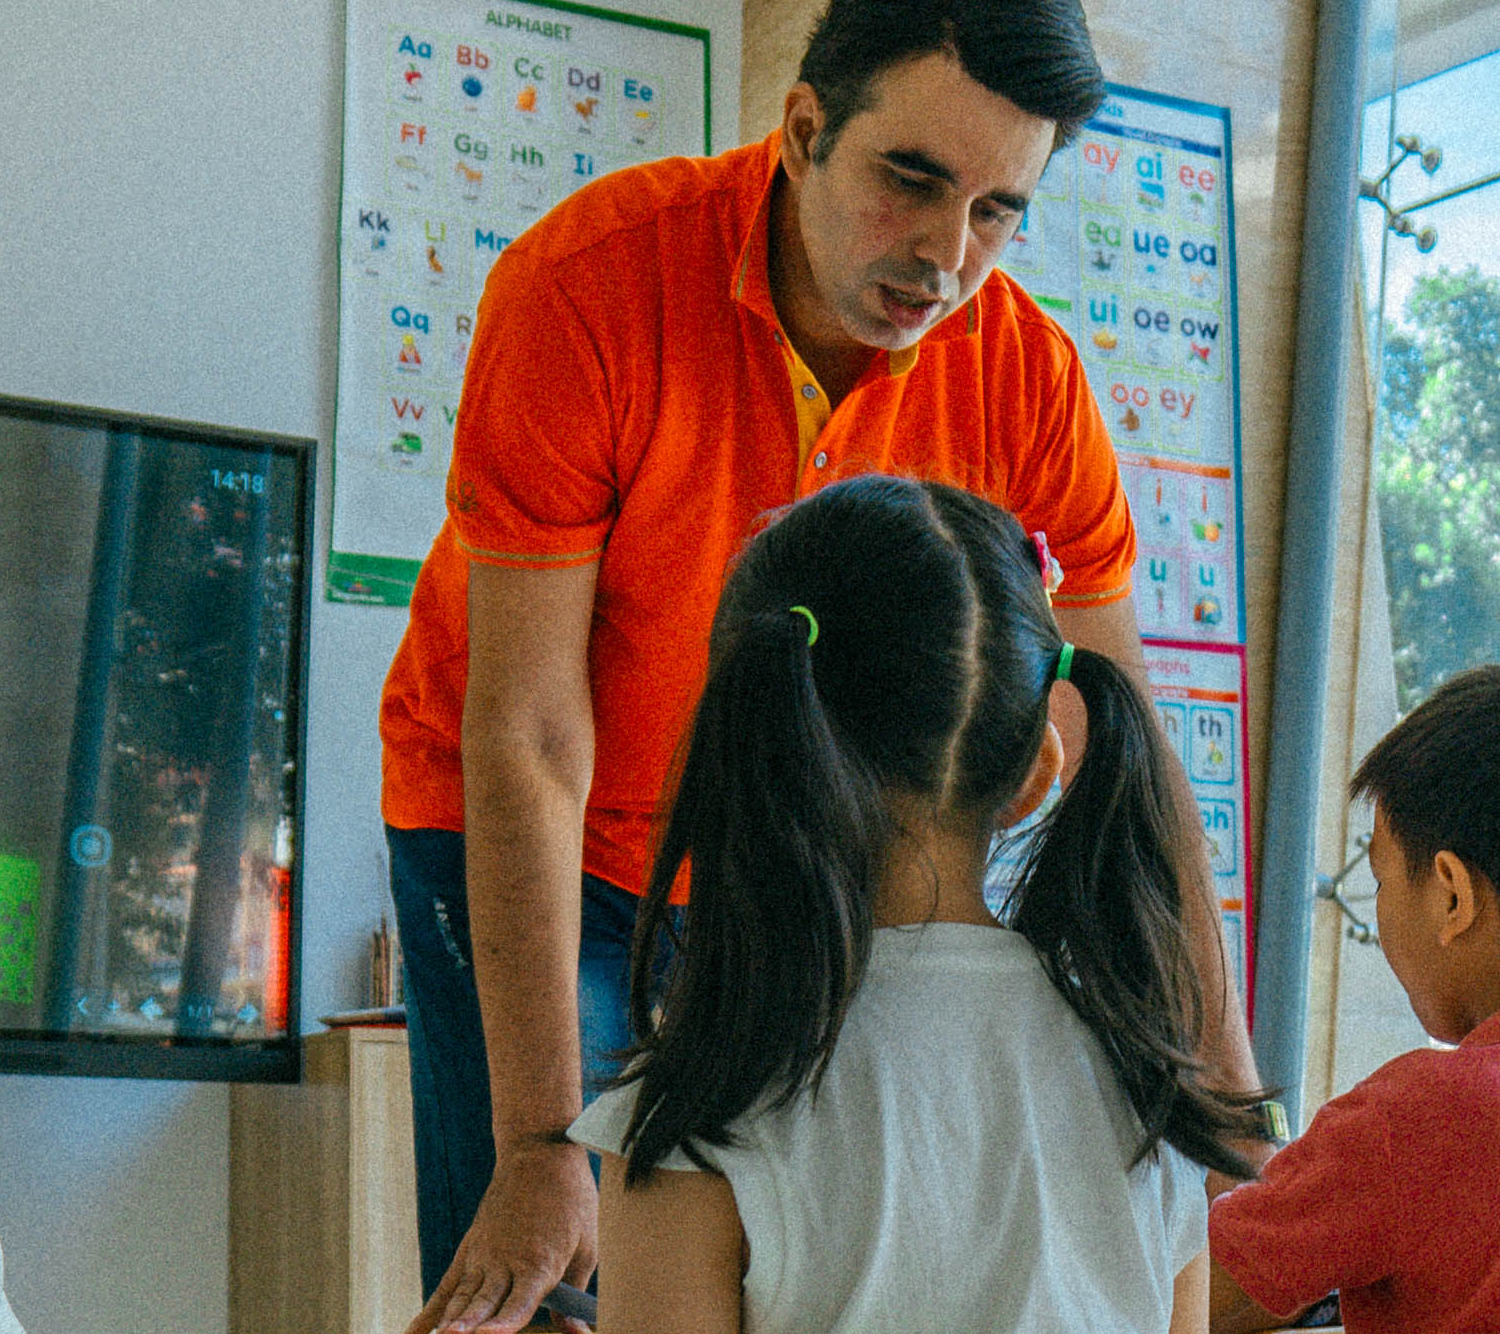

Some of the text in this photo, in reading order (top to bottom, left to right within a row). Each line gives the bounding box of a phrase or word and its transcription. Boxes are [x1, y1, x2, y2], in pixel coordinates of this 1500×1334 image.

[485, 9, 573, 41] ALPHABET
[398, 35, 653, 102] Aa Bb Cc Dd Ee
[400, 123, 593, 175] Ff Gg Hh Ii
[1083, 142, 1215, 191] ay ai ee
[359, 208, 391, 232] Kk
[425, 219, 447, 242] Ll
[1085, 221, 1217, 267] ea ue oa
[391, 305, 430, 334] Qq
[1090, 294, 1219, 340] ui oe ow
[391, 397, 424, 421] Vv
[1110, 383, 1196, 419] oo ey
[1156, 478, 1208, 513] i i
[1149, 558, 1215, 587] u u
[1199, 714, 1223, 738] th
